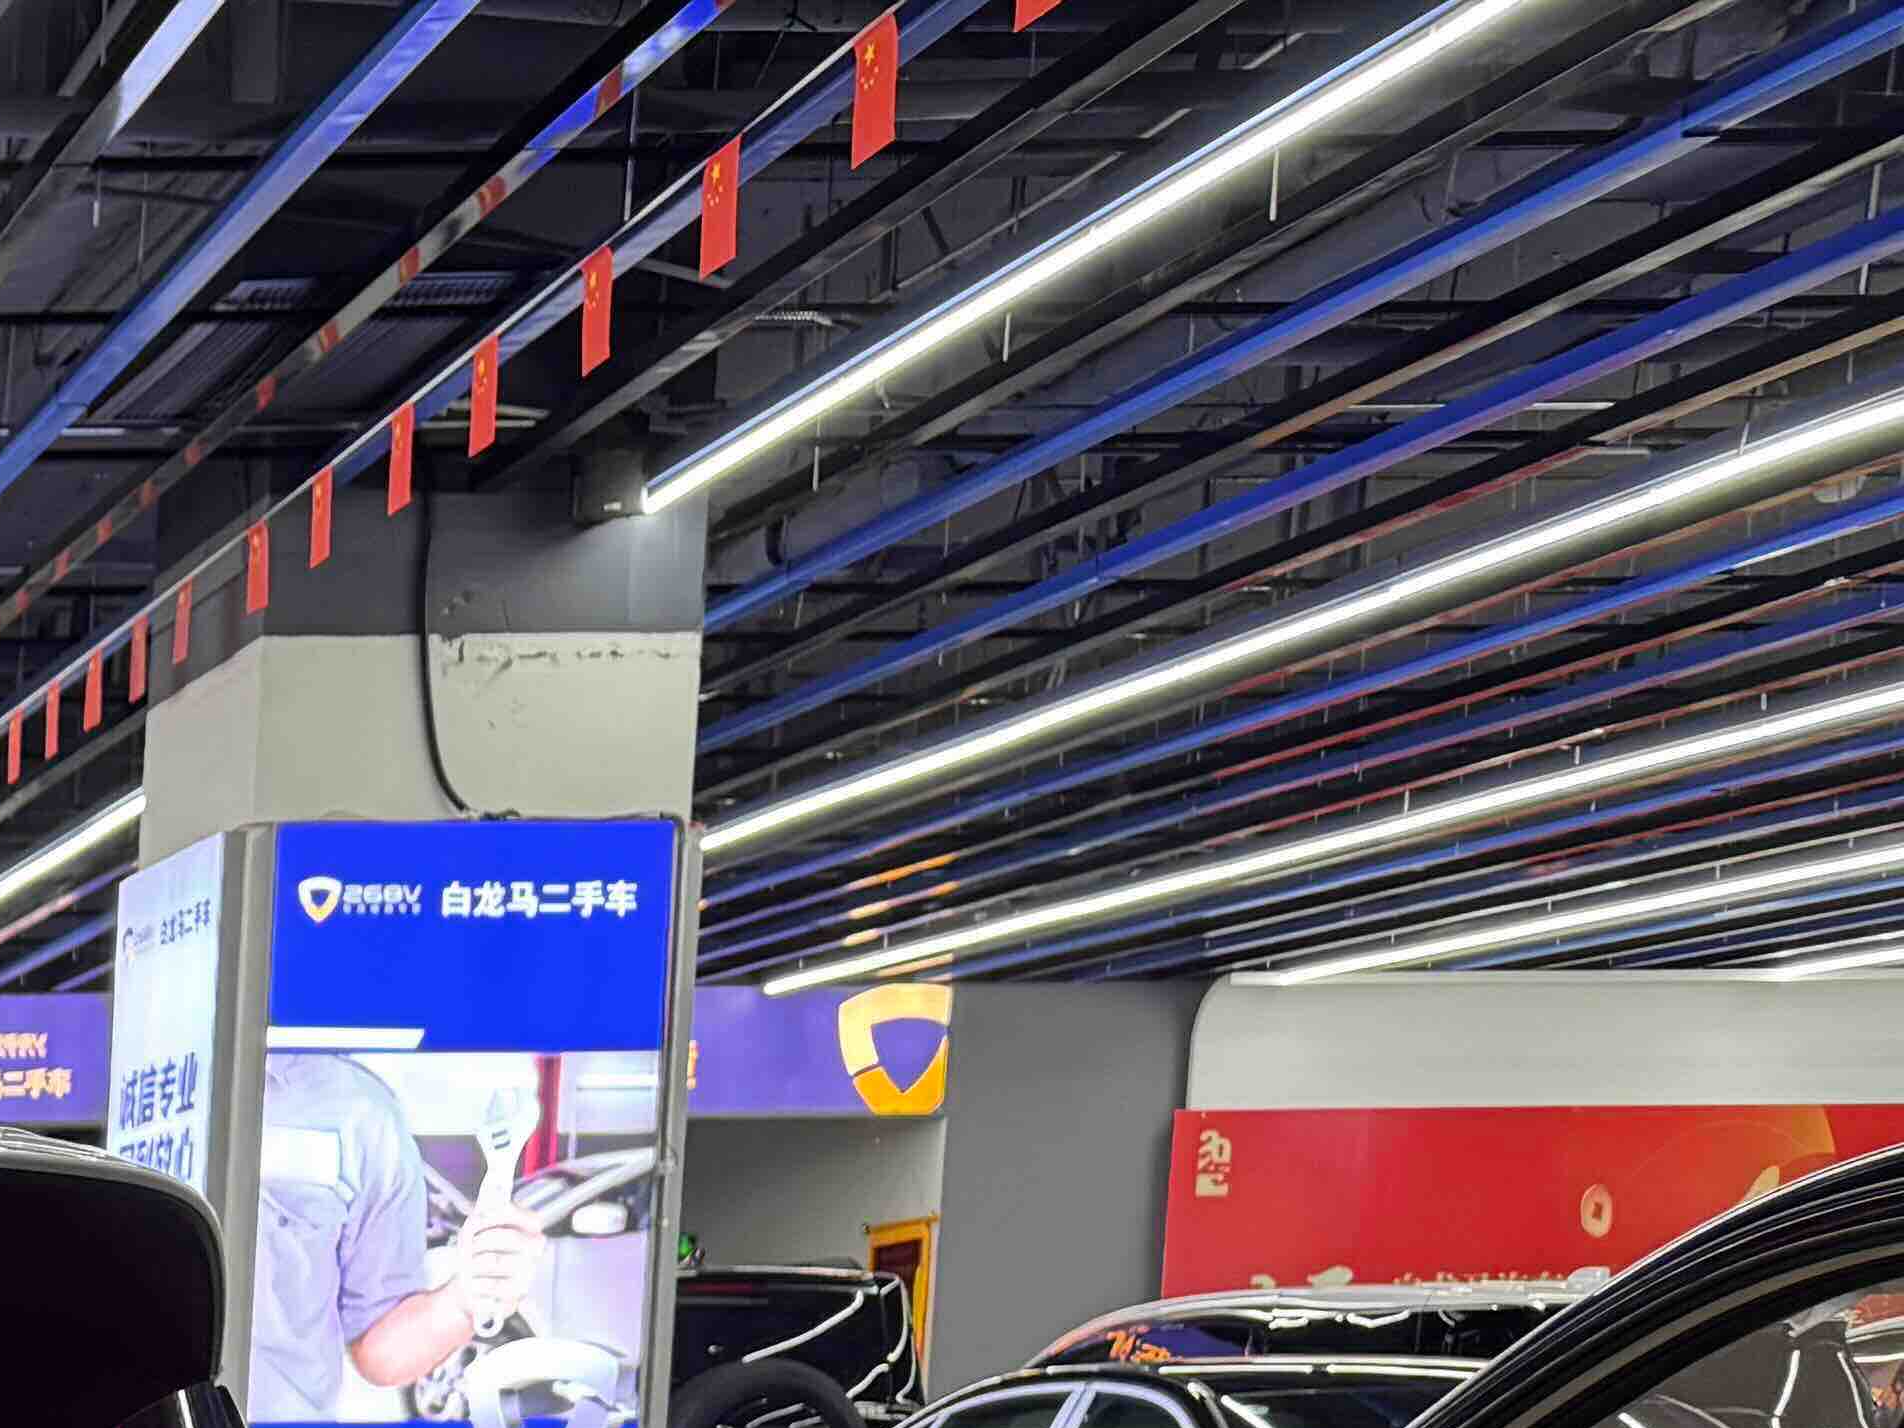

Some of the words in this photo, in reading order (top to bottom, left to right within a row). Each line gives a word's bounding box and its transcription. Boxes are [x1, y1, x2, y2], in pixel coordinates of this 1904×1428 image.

[441, 879, 638, 918] 白龙马二手车
[119, 1051, 198, 1130] 诚信专业
